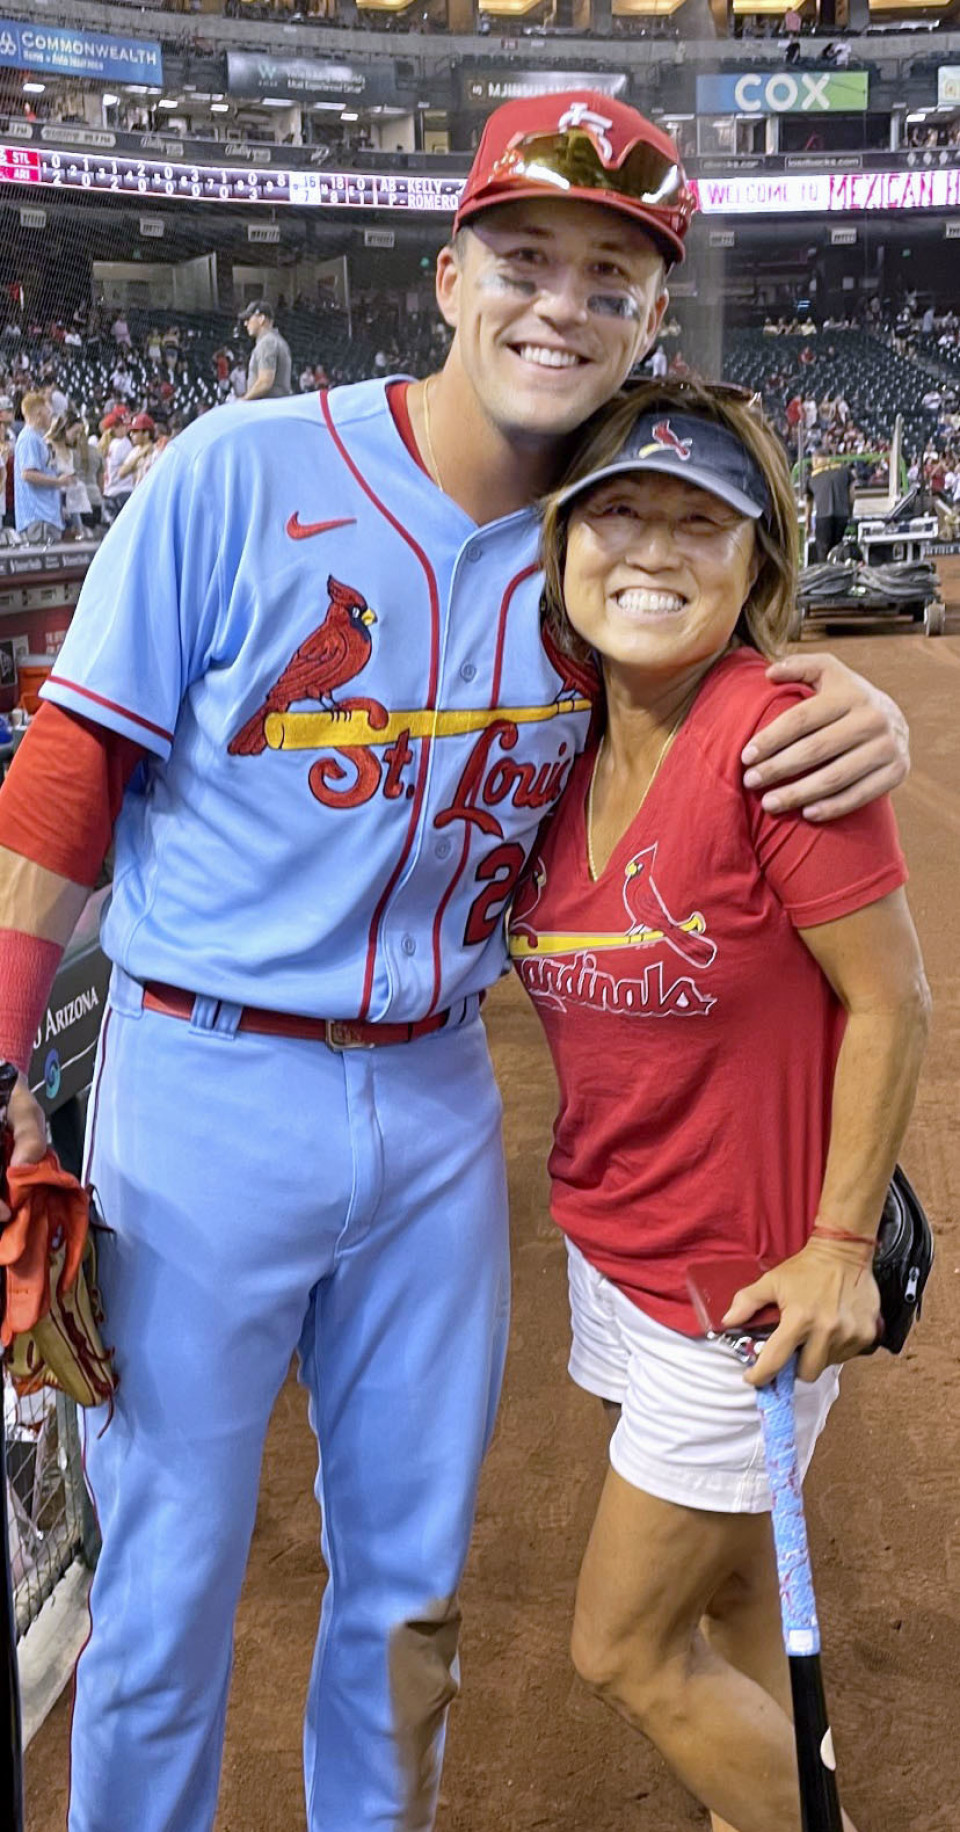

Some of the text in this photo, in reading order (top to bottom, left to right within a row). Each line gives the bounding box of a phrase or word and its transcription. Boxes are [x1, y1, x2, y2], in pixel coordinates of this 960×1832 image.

[21, 31, 157, 66] COMMONWEALTH
[735, 73, 831, 112] COX
[12, 151, 29, 163] STL
[52, 154, 61, 168] 0
[83, 158, 89, 172] 1
[111, 161, 118, 174] 1
[138, 163, 146, 177] 2
[164, 166, 173, 180] 0
[191, 169, 199, 182] 3
[221, 170, 227, 184] 1
[248, 172, 257, 186] 0
[304, 176, 316, 188] 16
[331, 176, 344, 190] 18
[357, 177, 365, 190] 0
[380, 179, 397, 192] AB
[408, 180, 441, 195] KELLY
[14, 169, 31, 180] ARI
[53, 171, 61, 185] 2
[82, 173, 91, 187] 0
[110, 176, 119, 189] 2
[138, 178, 146, 192] 0
[165, 181, 174, 195] 0
[192, 183, 200, 197] 0
[220, 185, 228, 199] 0
[249, 188, 258, 201] 3
[330, 190, 338, 203] 8
[389, 194, 397, 206] P
[408, 194, 459, 209] ROMERO
[707, 183, 788, 205] WELCOME
[828, 172, 935, 210] MEXICAN
[308, 698, 414, 809] St.
[45, 986, 99, 1042] ARIZONA
